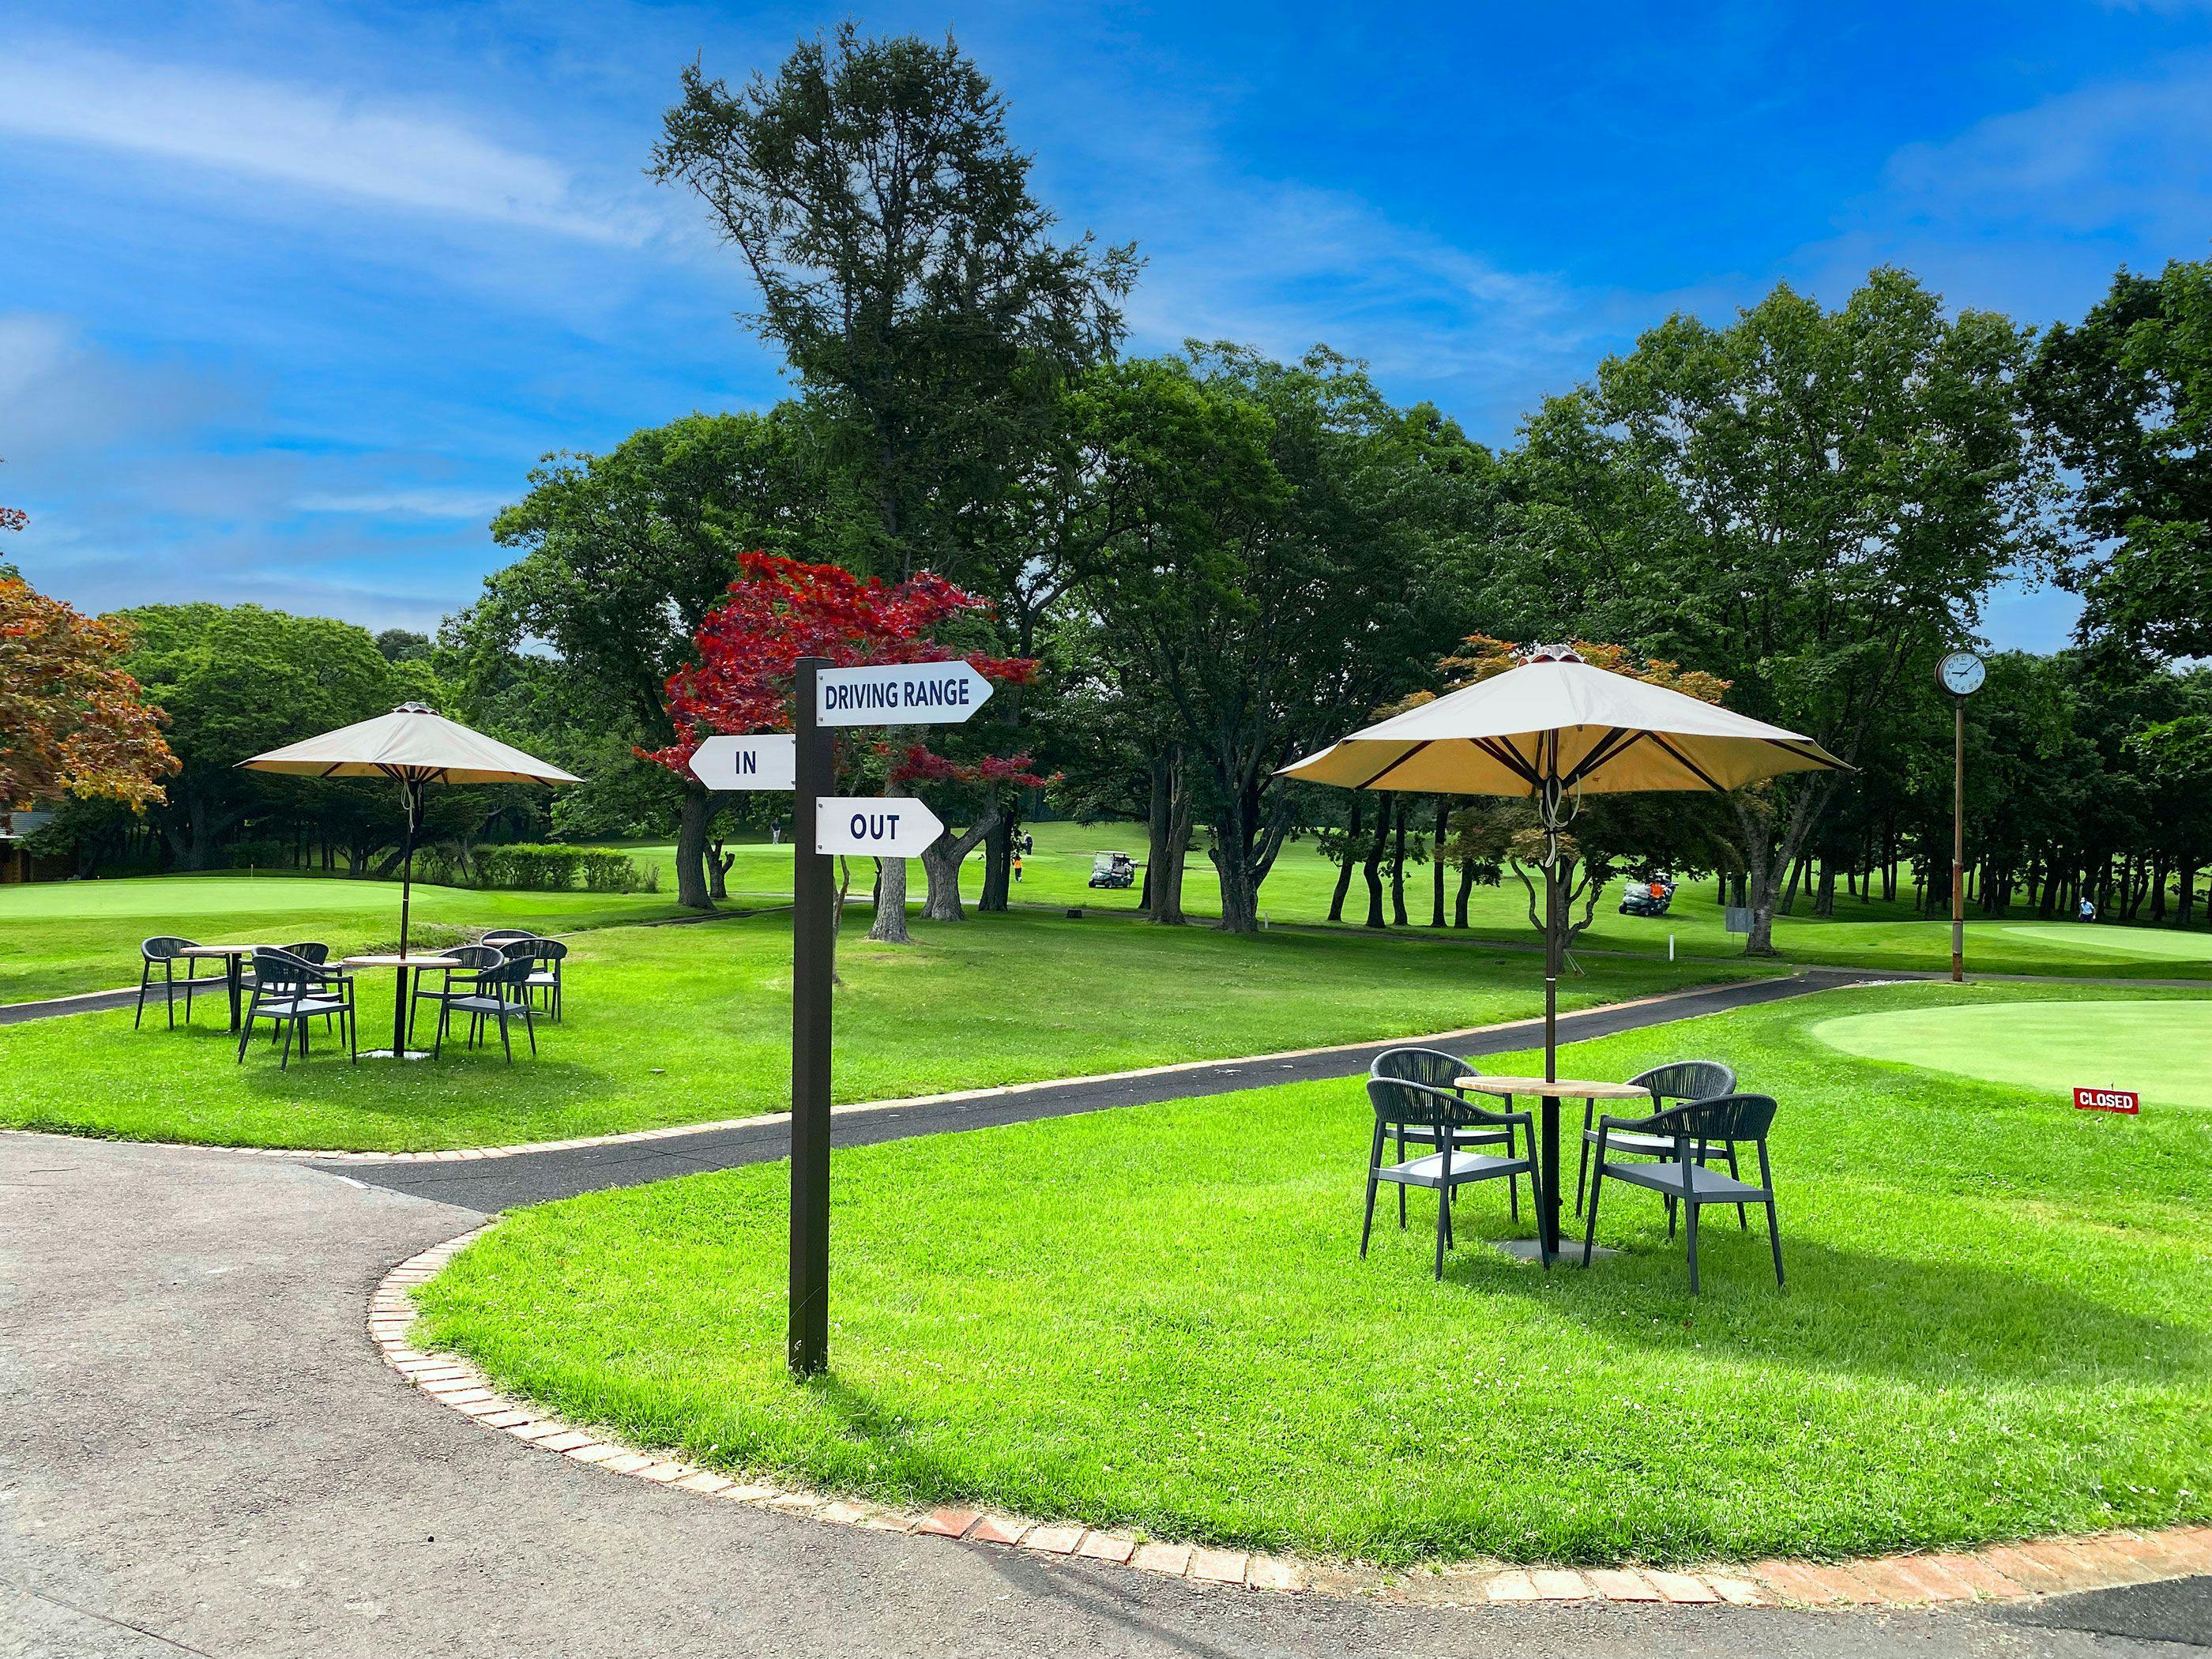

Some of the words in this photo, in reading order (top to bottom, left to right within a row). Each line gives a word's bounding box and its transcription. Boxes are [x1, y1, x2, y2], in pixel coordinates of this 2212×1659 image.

[826, 682, 897, 709] DRIVING
[905, 679, 969, 706] RANGE
[735, 750, 756, 774] IN
[850, 814, 900, 840] OUT
[2079, 1092, 2133, 1109] CLOSED
